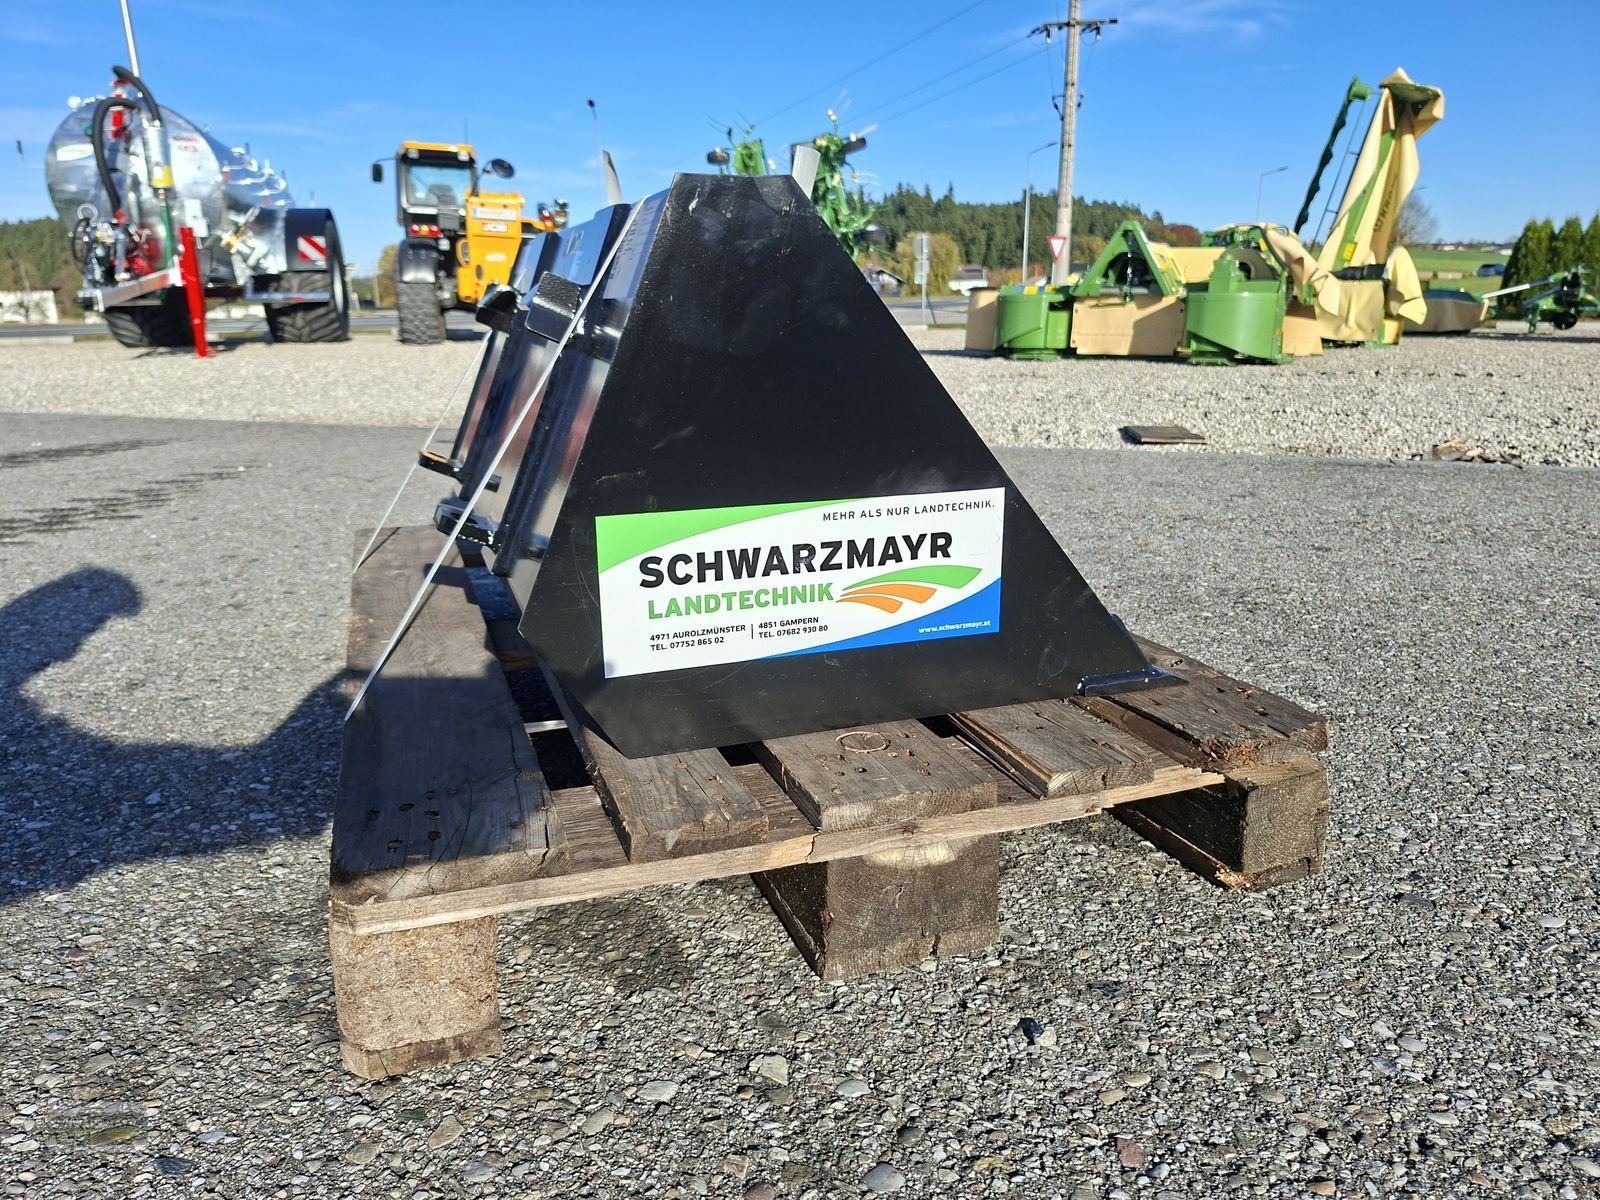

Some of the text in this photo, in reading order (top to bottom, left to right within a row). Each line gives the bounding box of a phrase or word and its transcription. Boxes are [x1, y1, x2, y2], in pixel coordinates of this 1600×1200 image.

[822, 500, 995, 521] MEHR ALS NUR LANDTECHNIK.
[639, 532, 952, 588] SCHWARZMAYR
[648, 582, 834, 620] LANDTECHNIK
[779, 616, 819, 628] GAMPERN
[918, 620, 991, 633] www.schwarzmayr.at
[650, 624, 746, 642] 4971 AUROLZMÜNSTER
[777, 628, 801, 637] 07682
[802, 626, 817, 634] 930
[670, 640, 695, 649] 07752
[697, 638, 712, 646] 865
